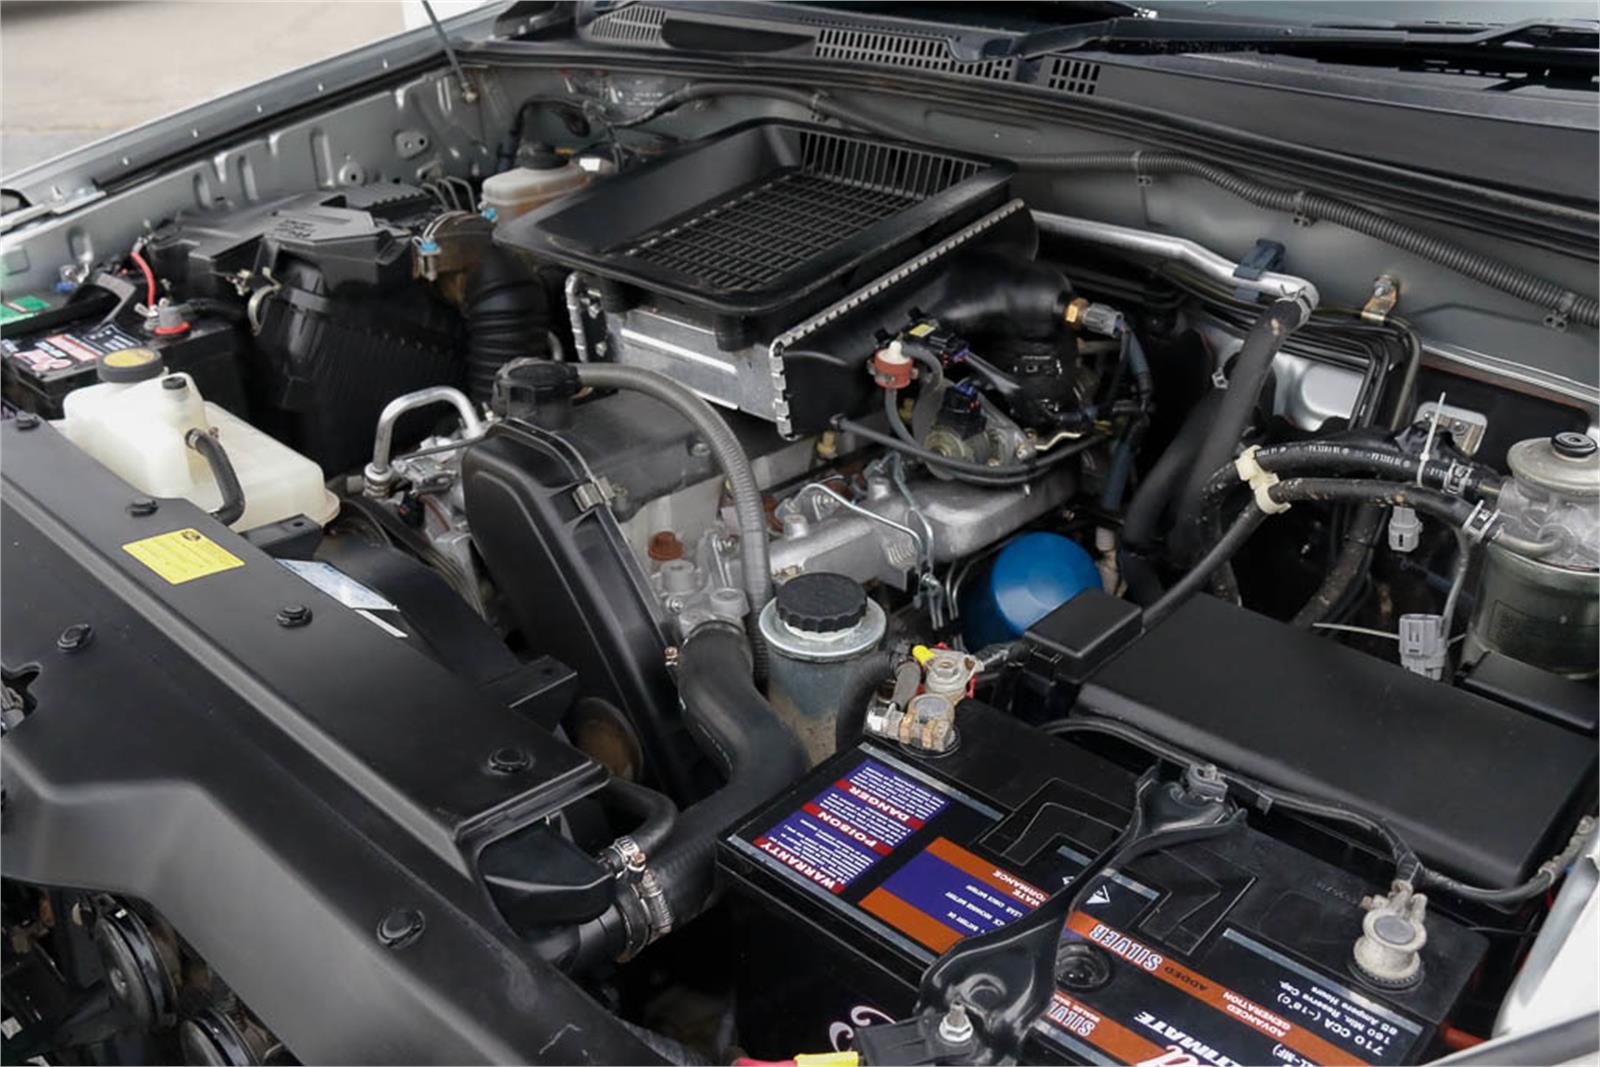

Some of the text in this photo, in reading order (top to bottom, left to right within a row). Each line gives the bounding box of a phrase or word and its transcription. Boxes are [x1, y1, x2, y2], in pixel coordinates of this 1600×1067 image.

[847, 785, 910, 821] DANGER
[816, 810, 877, 847] POISON
[759, 841, 835, 889] WARRANTY
[1088, 922, 1207, 990] ADDED SILVER
[1222, 991, 1291, 1030] GENERATION
[1301, 993, 1340, 1017] Reserve
[1310, 986, 1339, 1004] Hours
[1225, 1003, 1285, 1037] ADVANCED
[1322, 1017, 1351, 1037] CCA
[1340, 1002, 1379, 1025] Ampere
[1353, 1033, 1384, 1055] 710
